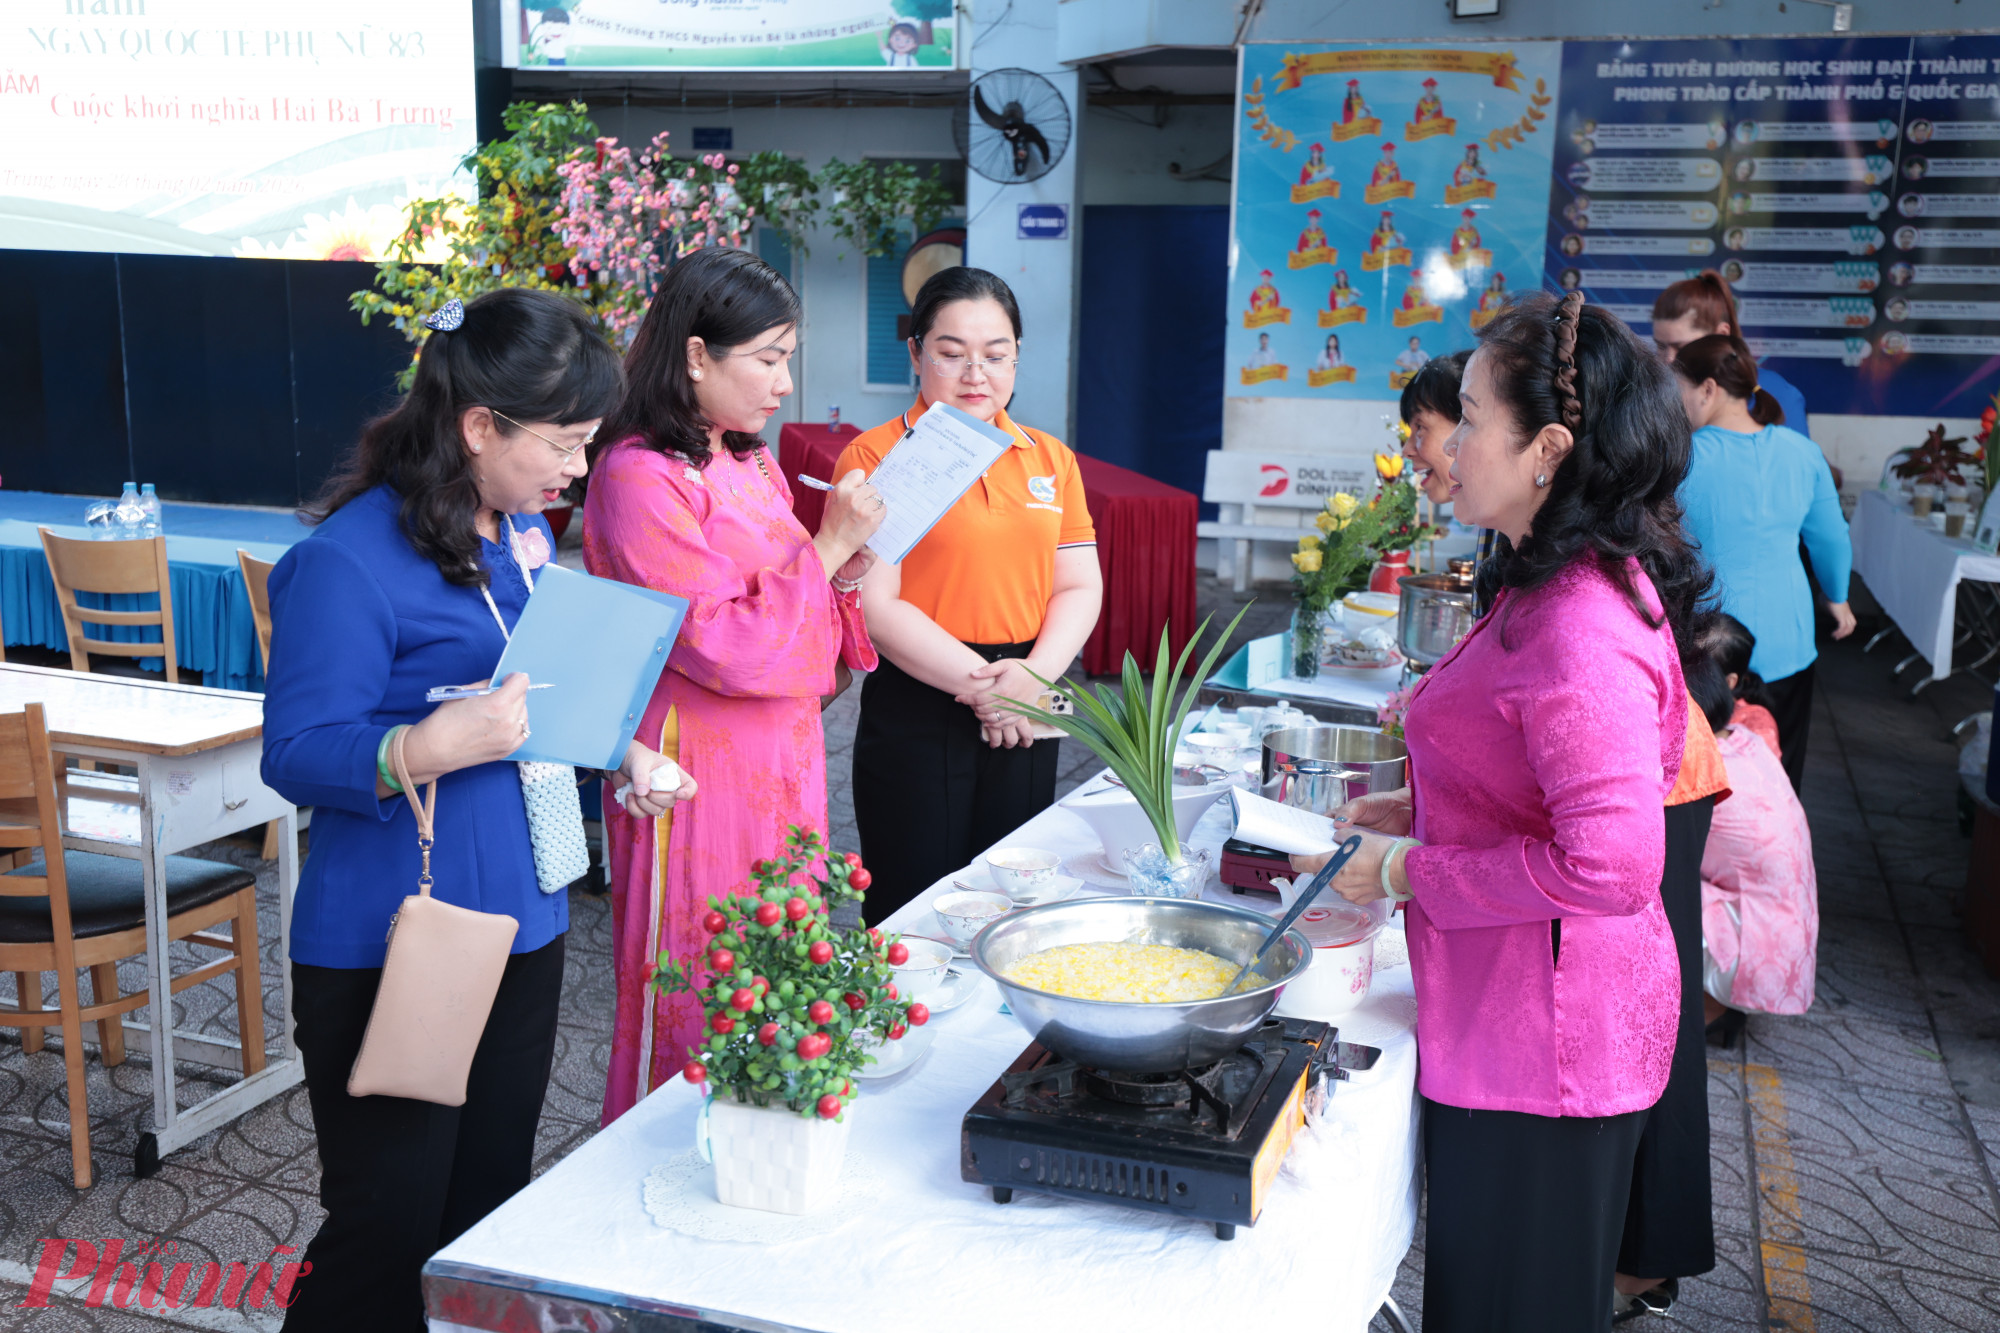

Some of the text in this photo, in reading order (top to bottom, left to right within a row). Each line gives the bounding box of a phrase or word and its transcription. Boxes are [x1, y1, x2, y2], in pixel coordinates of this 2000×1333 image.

[388, 30, 426, 57] 8/3
[1597, 58, 1648, 78] BẢNG
[1651, 58, 1711, 77] TUYÊN
[1784, 61, 1823, 80] HỌC
[1826, 60, 1873, 76] SINH
[1876, 60, 1914, 80] ĐẠT
[1919, 55, 1987, 75] THÀNH
[0, 68, 40, 94] ĂM
[191, 96, 260, 126] nghĩa
[272, 97, 315, 121] Hai
[368, 97, 454, 130] Trưng
[1614, 86, 1677, 102] PHONG
[1681, 83, 1731, 102] TRÀO
[1734, 79, 1772, 101] CẤP
[1775, 82, 1841, 101] THÀNH
[1843, 78, 1884, 101] PHỐ
[1908, 77, 1961, 101] QUỐC
[1298, 468, 1328, 481] DOL
